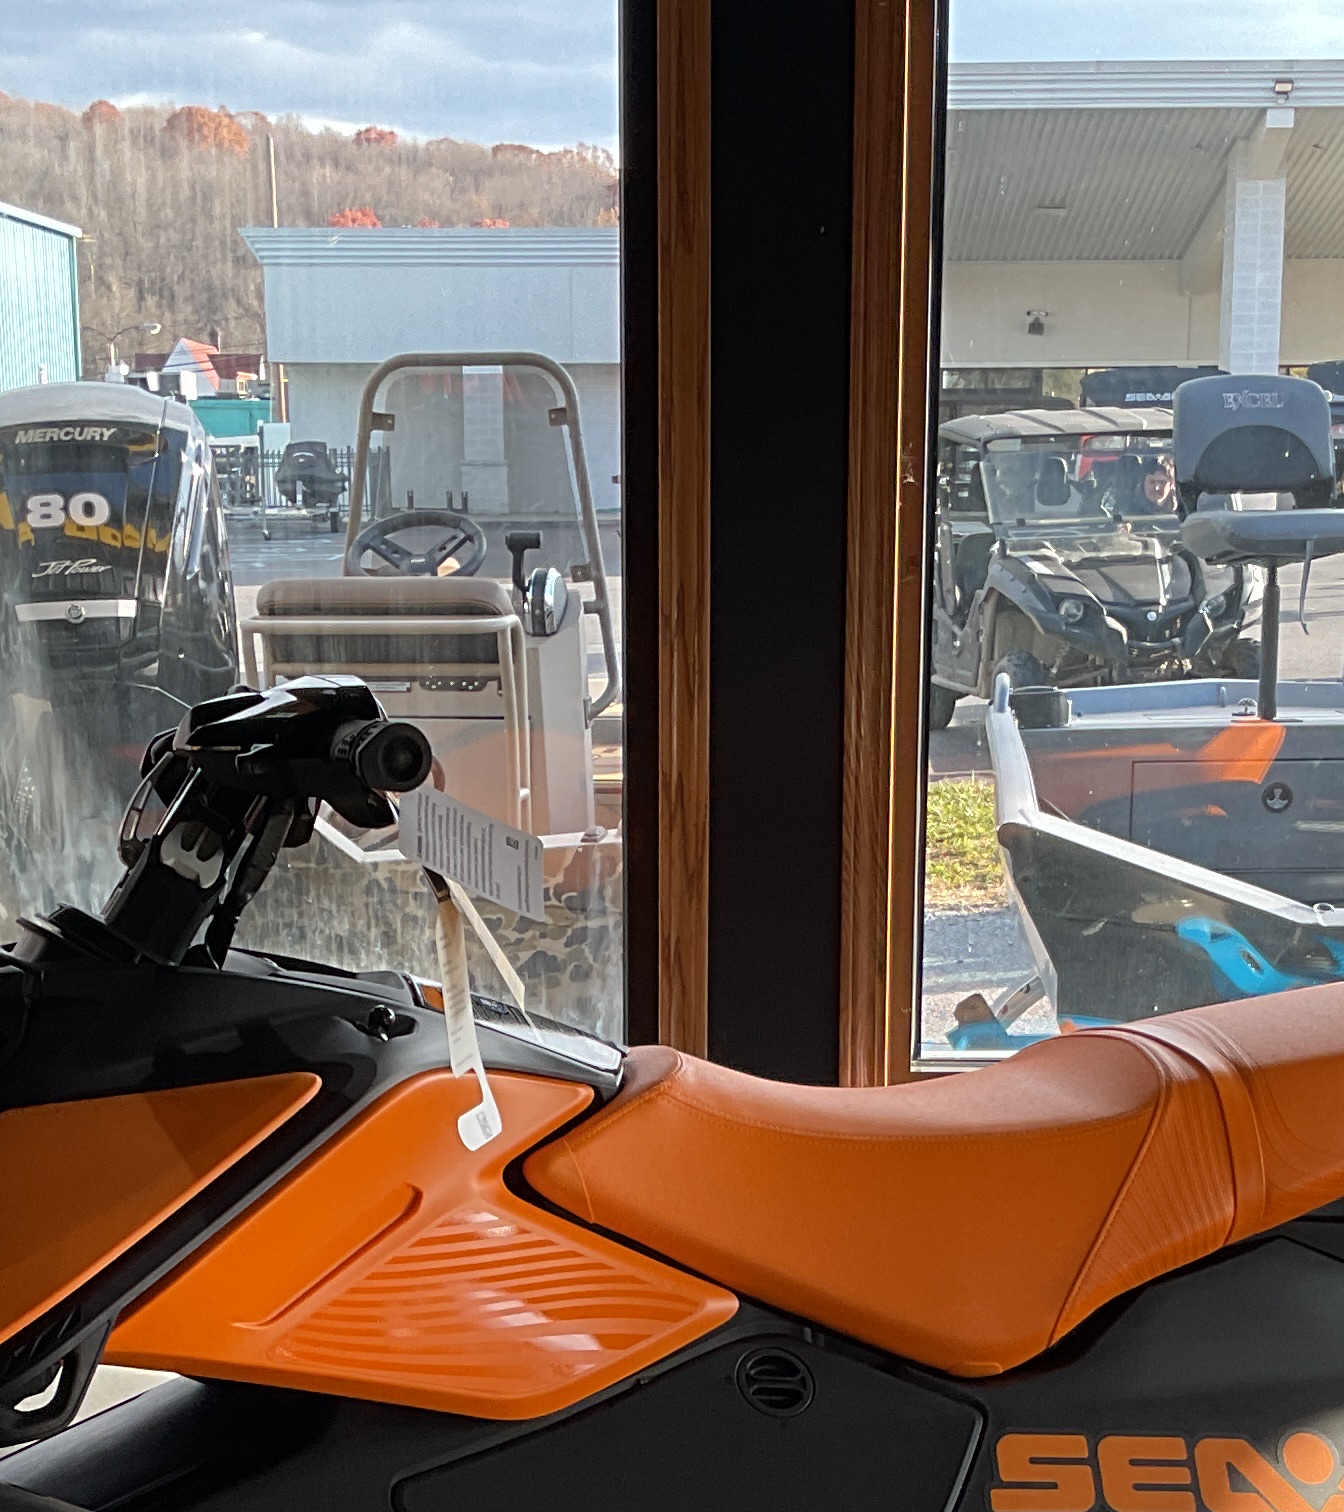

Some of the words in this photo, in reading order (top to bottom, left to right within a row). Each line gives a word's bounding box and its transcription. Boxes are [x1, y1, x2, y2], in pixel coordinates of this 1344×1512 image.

[14, 427, 117, 445] MERCURY
[27, 492, 110, 528] 80
[64, 558, 112, 575] Power
